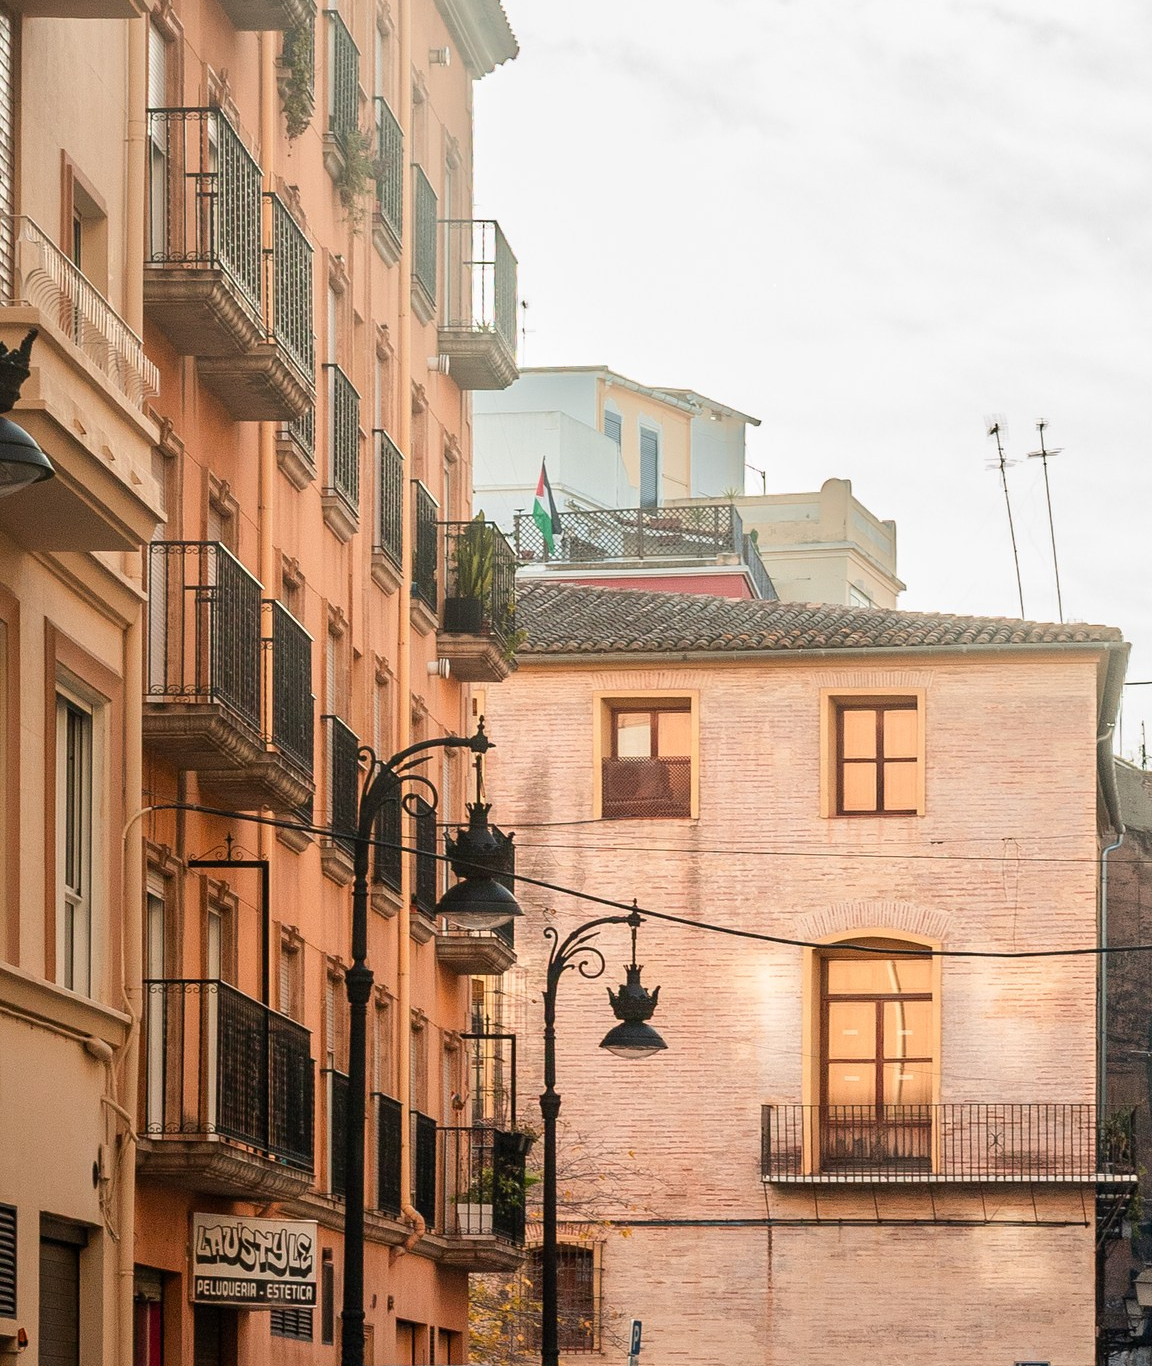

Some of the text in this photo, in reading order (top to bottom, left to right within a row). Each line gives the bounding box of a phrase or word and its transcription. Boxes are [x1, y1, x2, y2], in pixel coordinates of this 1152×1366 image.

[196, 1280, 257, 1297] PELUQUERIA
[266, 1284, 313, 1300] ESTETICA
[632, 1325, 640, 1351] P
